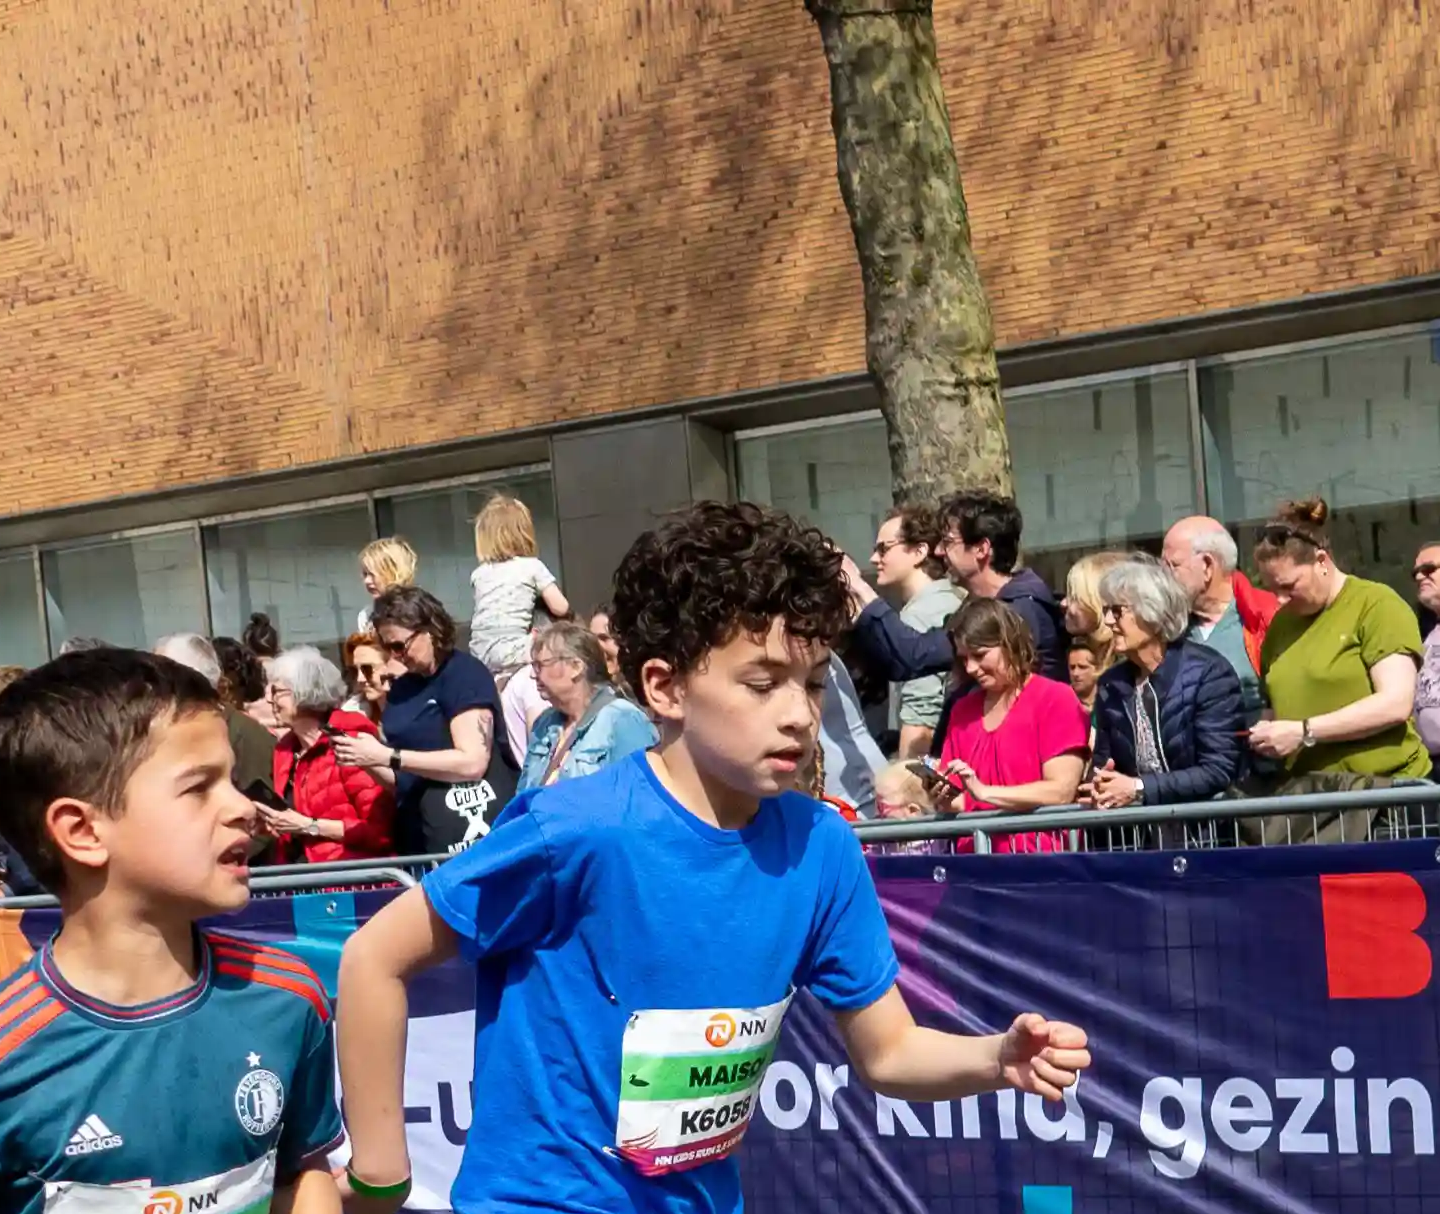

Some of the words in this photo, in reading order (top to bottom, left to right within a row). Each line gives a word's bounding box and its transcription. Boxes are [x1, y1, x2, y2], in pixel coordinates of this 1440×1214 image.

[739, 1019, 767, 1037] NN
[680, 1095, 752, 1135] K6058
[1140, 1046, 1435, 1179] gezin
[65, 1134, 123, 1155] adidas
[188, 1191, 219, 1213] NN
